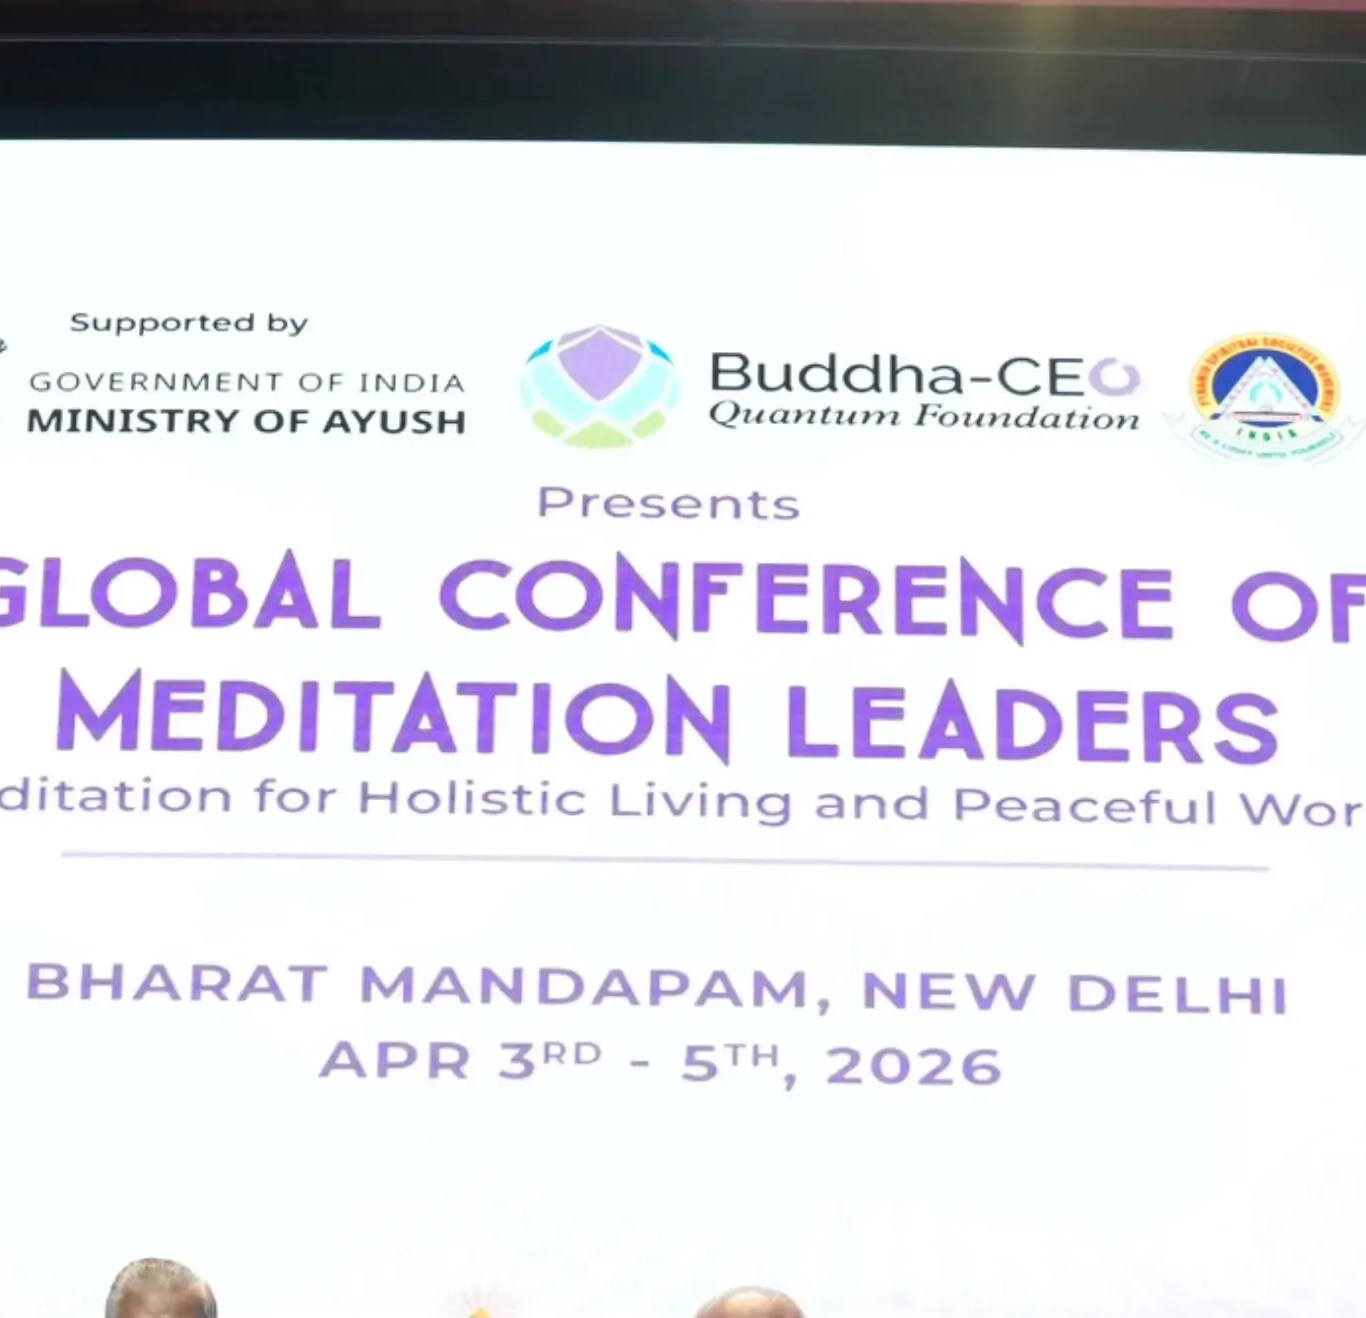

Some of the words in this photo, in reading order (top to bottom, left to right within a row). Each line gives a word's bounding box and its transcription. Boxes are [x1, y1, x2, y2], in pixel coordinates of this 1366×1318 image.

[70, 312, 255, 337] Supported
[267, 312, 309, 338] by
[29, 371, 283, 393] GOVERNMENT
[298, 372, 343, 393] OF
[360, 372, 465, 393] INDIA
[710, 351, 1144, 398] Buddha-CEO
[27, 408, 240, 434] MINISTRY
[253, 408, 311, 435] OF
[322, 409, 466, 435] AYUSH
[708, 400, 900, 430] Quantum
[914, 403, 1140, 431] Foundation
[538, 485, 800, 521] Presents
[438, 550, 1174, 648] CONFERENCE
[55, 666, 731, 768] MEDITATION
[787, 676, 1279, 766] LEADERS
[253, 777, 338, 814] for
[359, 778, 586, 817] Holistic
[611, 780, 791, 828] Living
[815, 784, 928, 821] and
[955, 787, 1215, 826] Peaceful
[26, 962, 329, 1003] BHARAT
[360, 965, 831, 1017] MANDAPAM,
[863, 971, 1037, 1012] NEW
[1068, 974, 1286, 1016] DELHI
[317, 1040, 470, 1080] APR
[826, 1046, 1002, 1086] 2026
